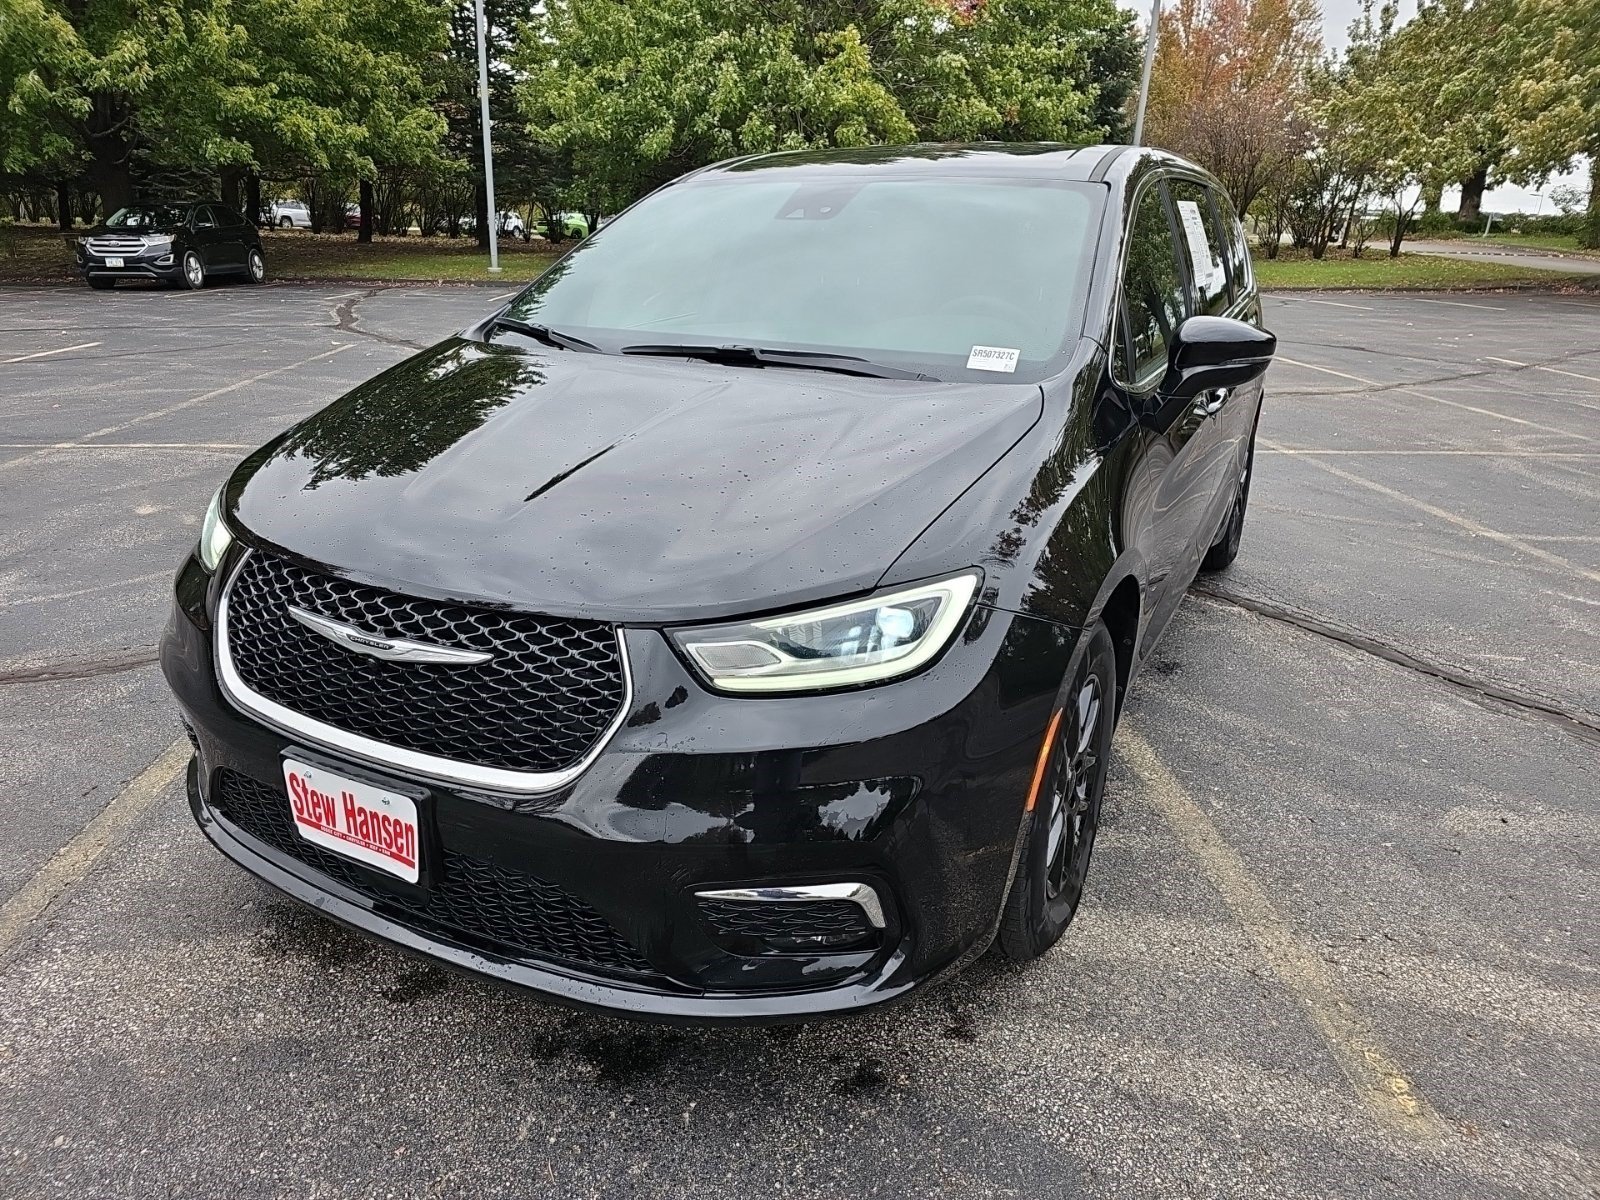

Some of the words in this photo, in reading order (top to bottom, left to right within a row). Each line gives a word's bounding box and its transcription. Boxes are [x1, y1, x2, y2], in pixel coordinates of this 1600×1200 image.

[972, 349, 1015, 360] SR507327C
[350, 636, 389, 650] CHRYSLER
[289, 772, 337, 829] Stew
[341, 790, 415, 860] Hansen
